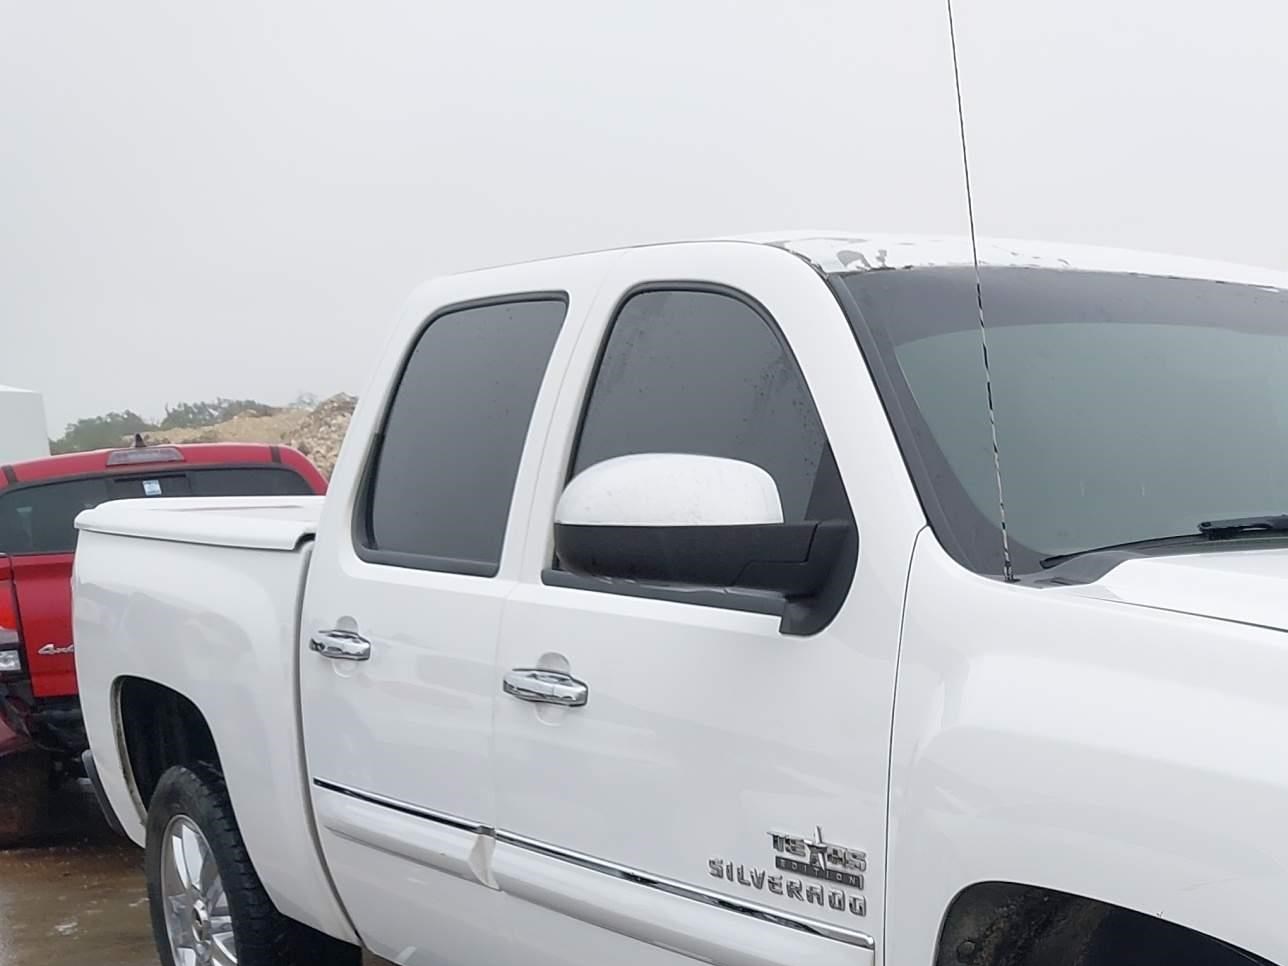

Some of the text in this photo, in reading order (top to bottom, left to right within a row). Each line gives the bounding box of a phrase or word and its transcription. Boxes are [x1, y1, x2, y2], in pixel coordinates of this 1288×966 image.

[767, 828, 867, 872] TEXAS
[779, 858, 858, 886] EDITION
[708, 857, 867, 917] SILVERADO
